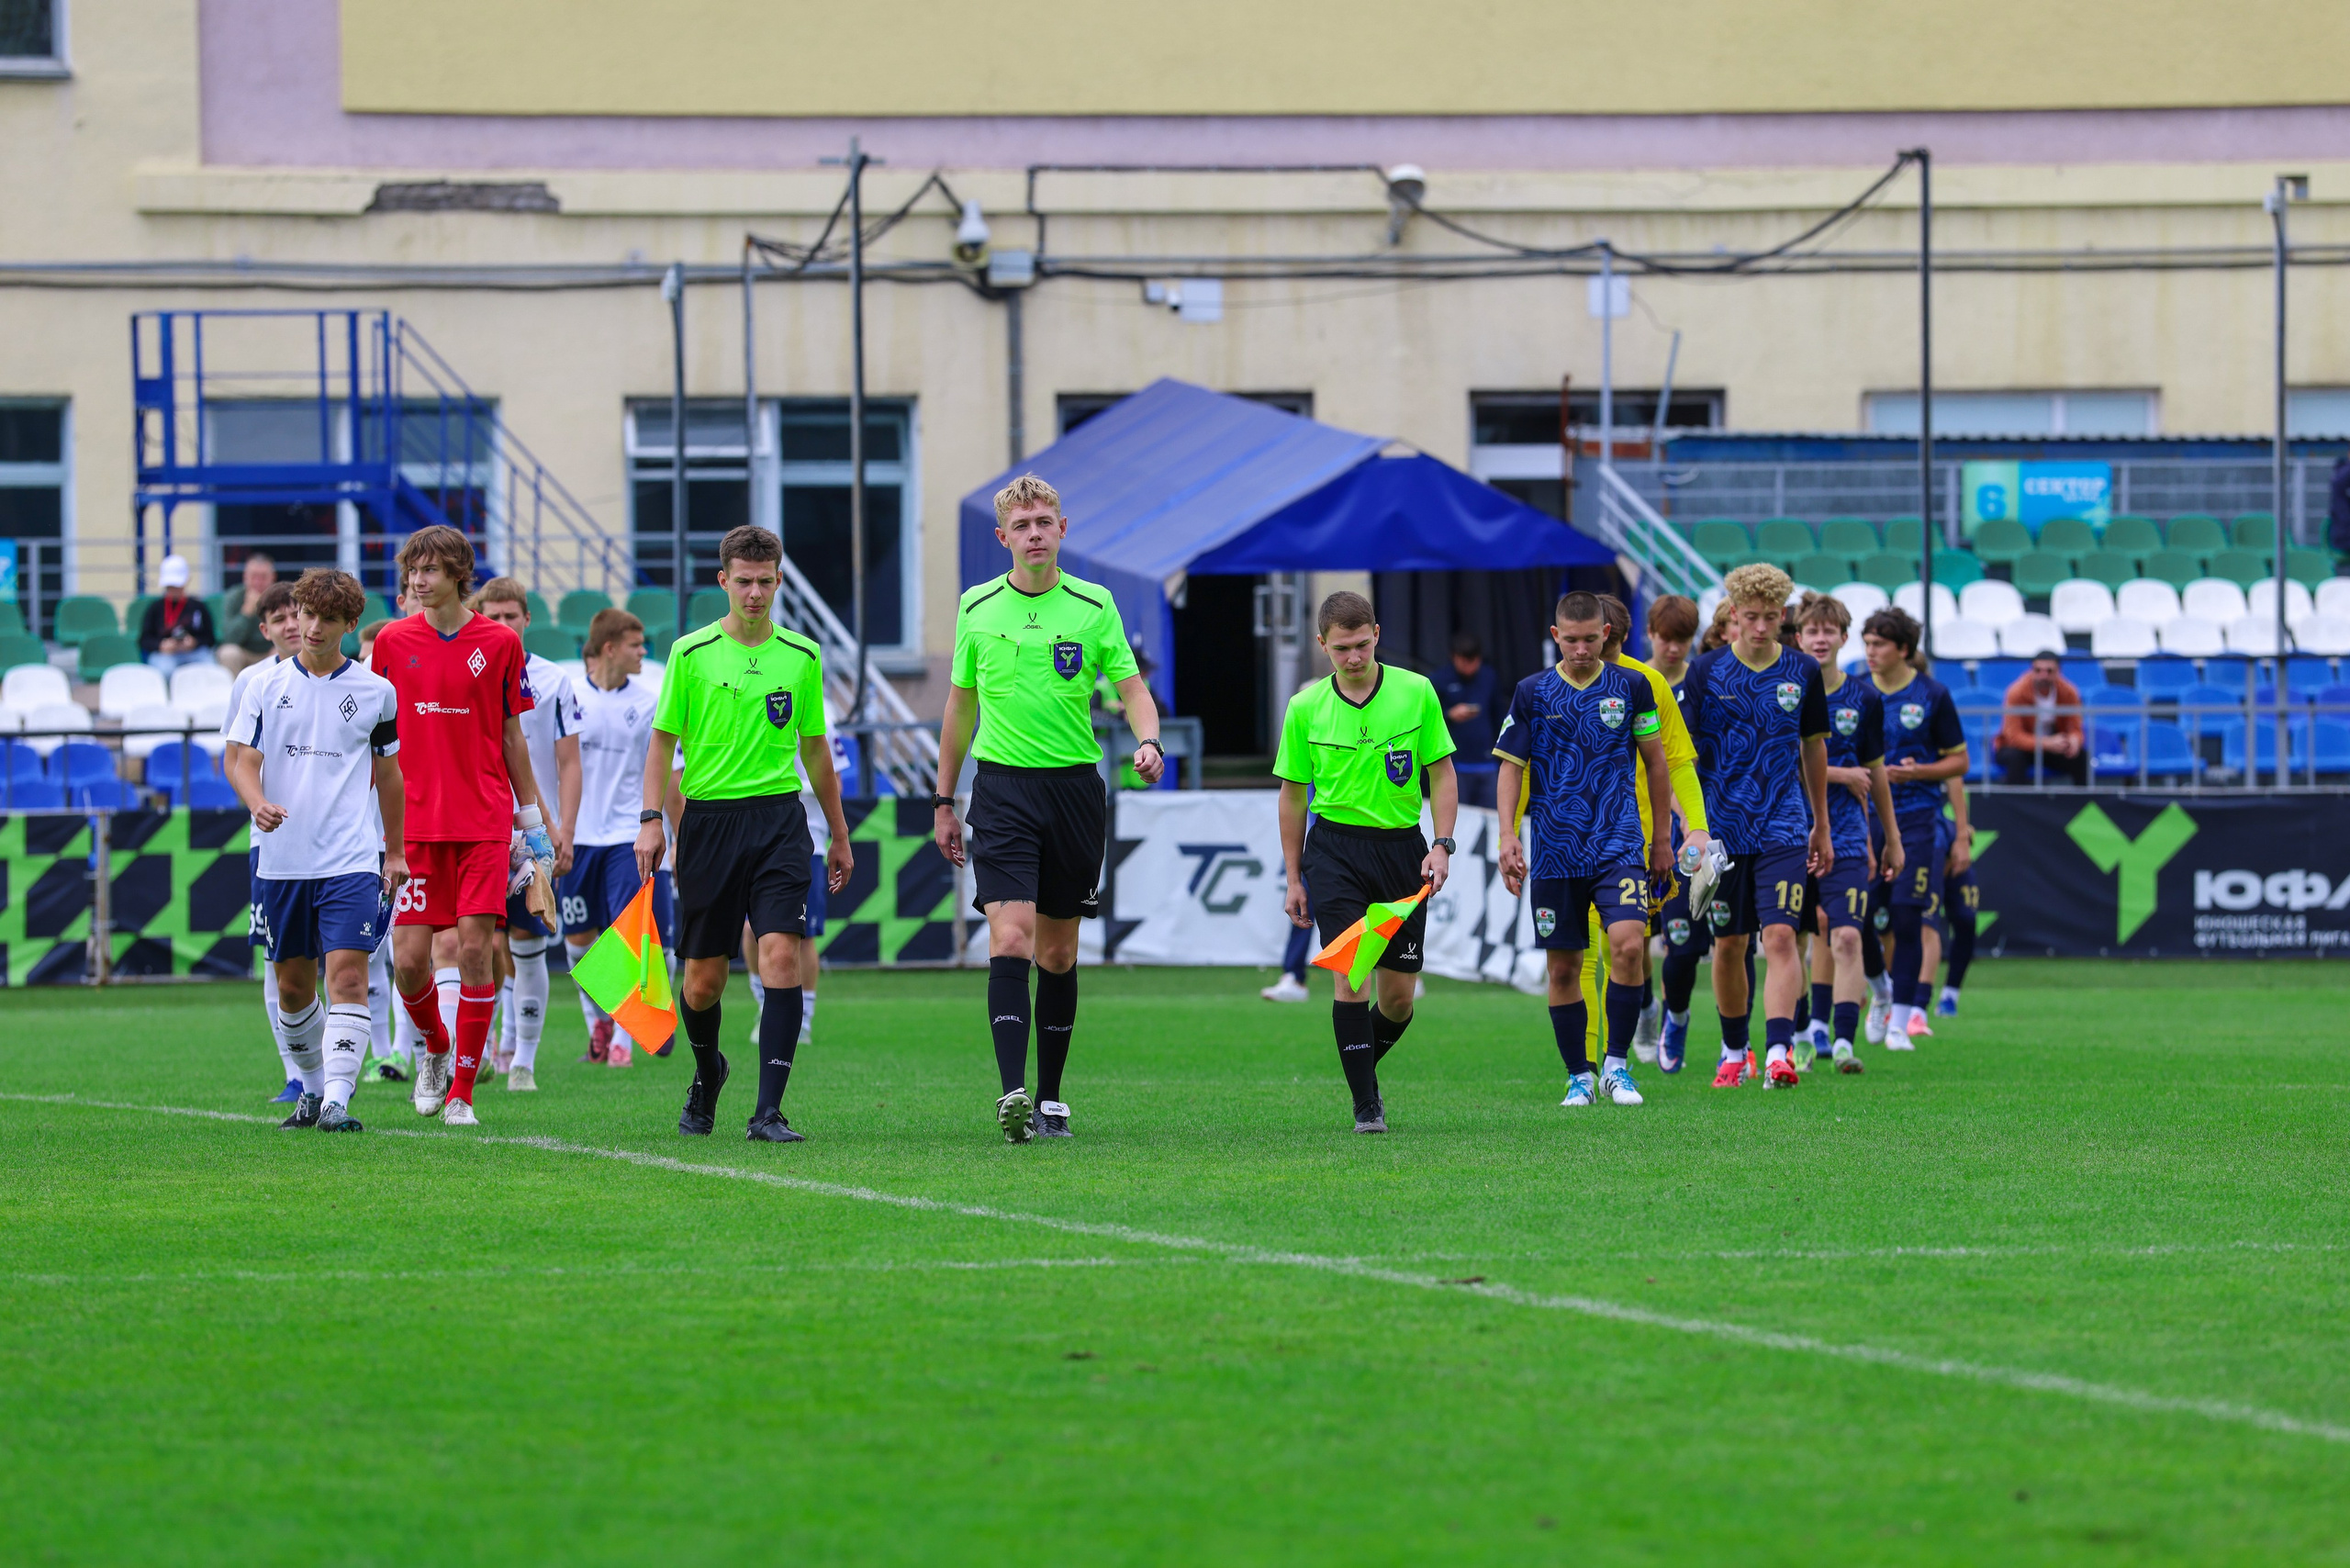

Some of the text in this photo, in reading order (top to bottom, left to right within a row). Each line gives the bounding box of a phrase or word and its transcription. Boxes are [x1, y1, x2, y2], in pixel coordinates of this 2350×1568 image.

[1976, 483, 2006, 521] 6
[1617, 878, 1648, 908] 25
[1915, 867, 1929, 893] 5
[561, 895, 588, 925] 89
[1775, 879, 1804, 913] 18
[1845, 887, 1868, 918] 11
[2194, 914, 2307, 931] ЮНОШЕСКАЯ
[2194, 930, 2307, 948] ФУТБОЛЬНАЯ
